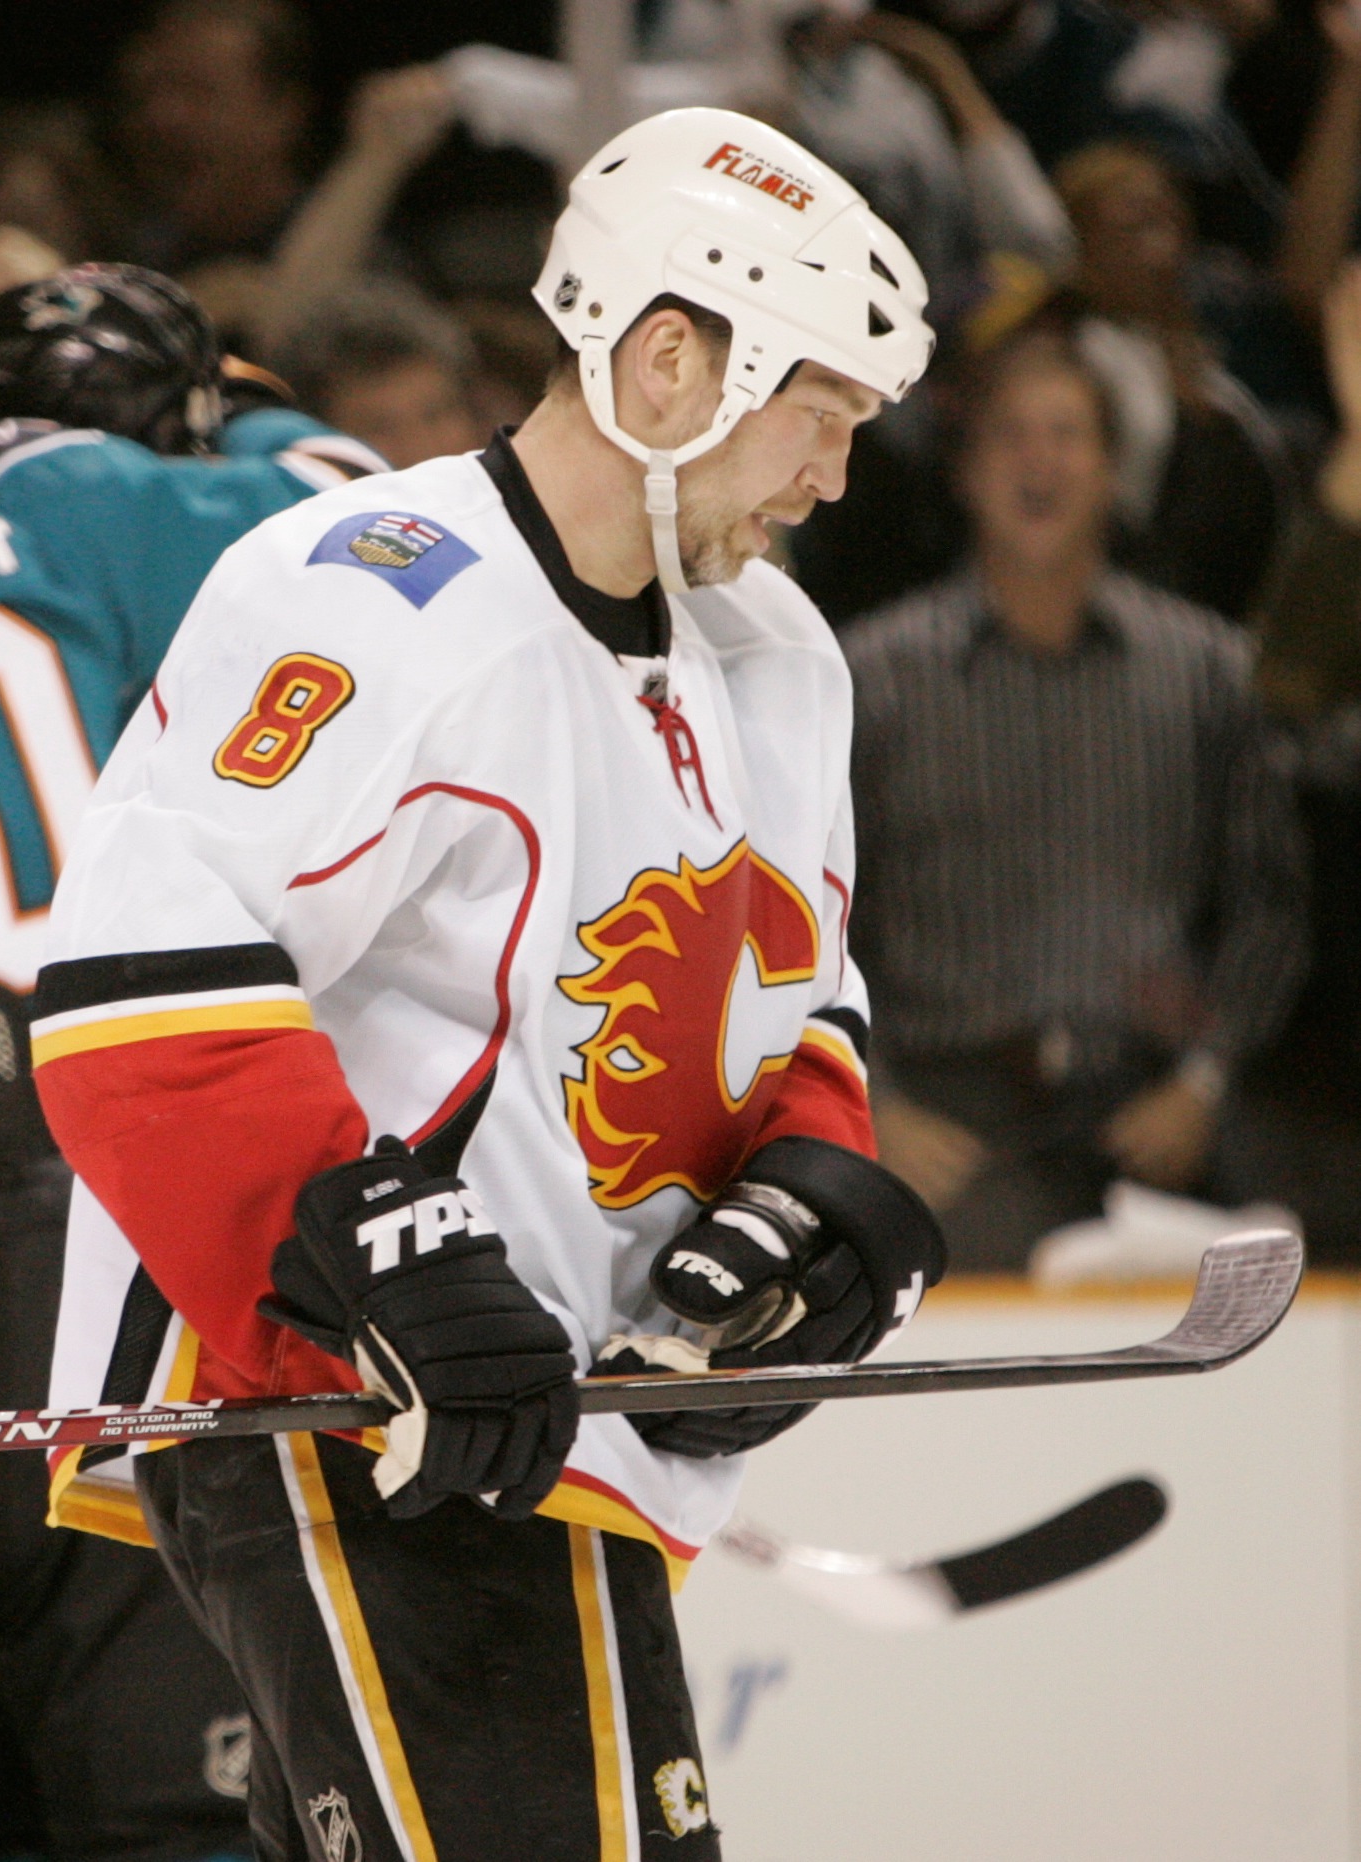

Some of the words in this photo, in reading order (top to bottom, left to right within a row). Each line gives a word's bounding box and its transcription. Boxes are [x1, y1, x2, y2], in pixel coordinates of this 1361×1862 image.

[701, 141, 815, 212] FLAMES
[213, 651, 355, 790] 8
[667, 1250, 744, 1297] TPS
[99, 1426, 123, 1437] NO
[127, 1421, 219, 1435] WARRANTY
[105, 1413, 176, 1426] CUSTOM
[180, 1410, 215, 1421] PRO
